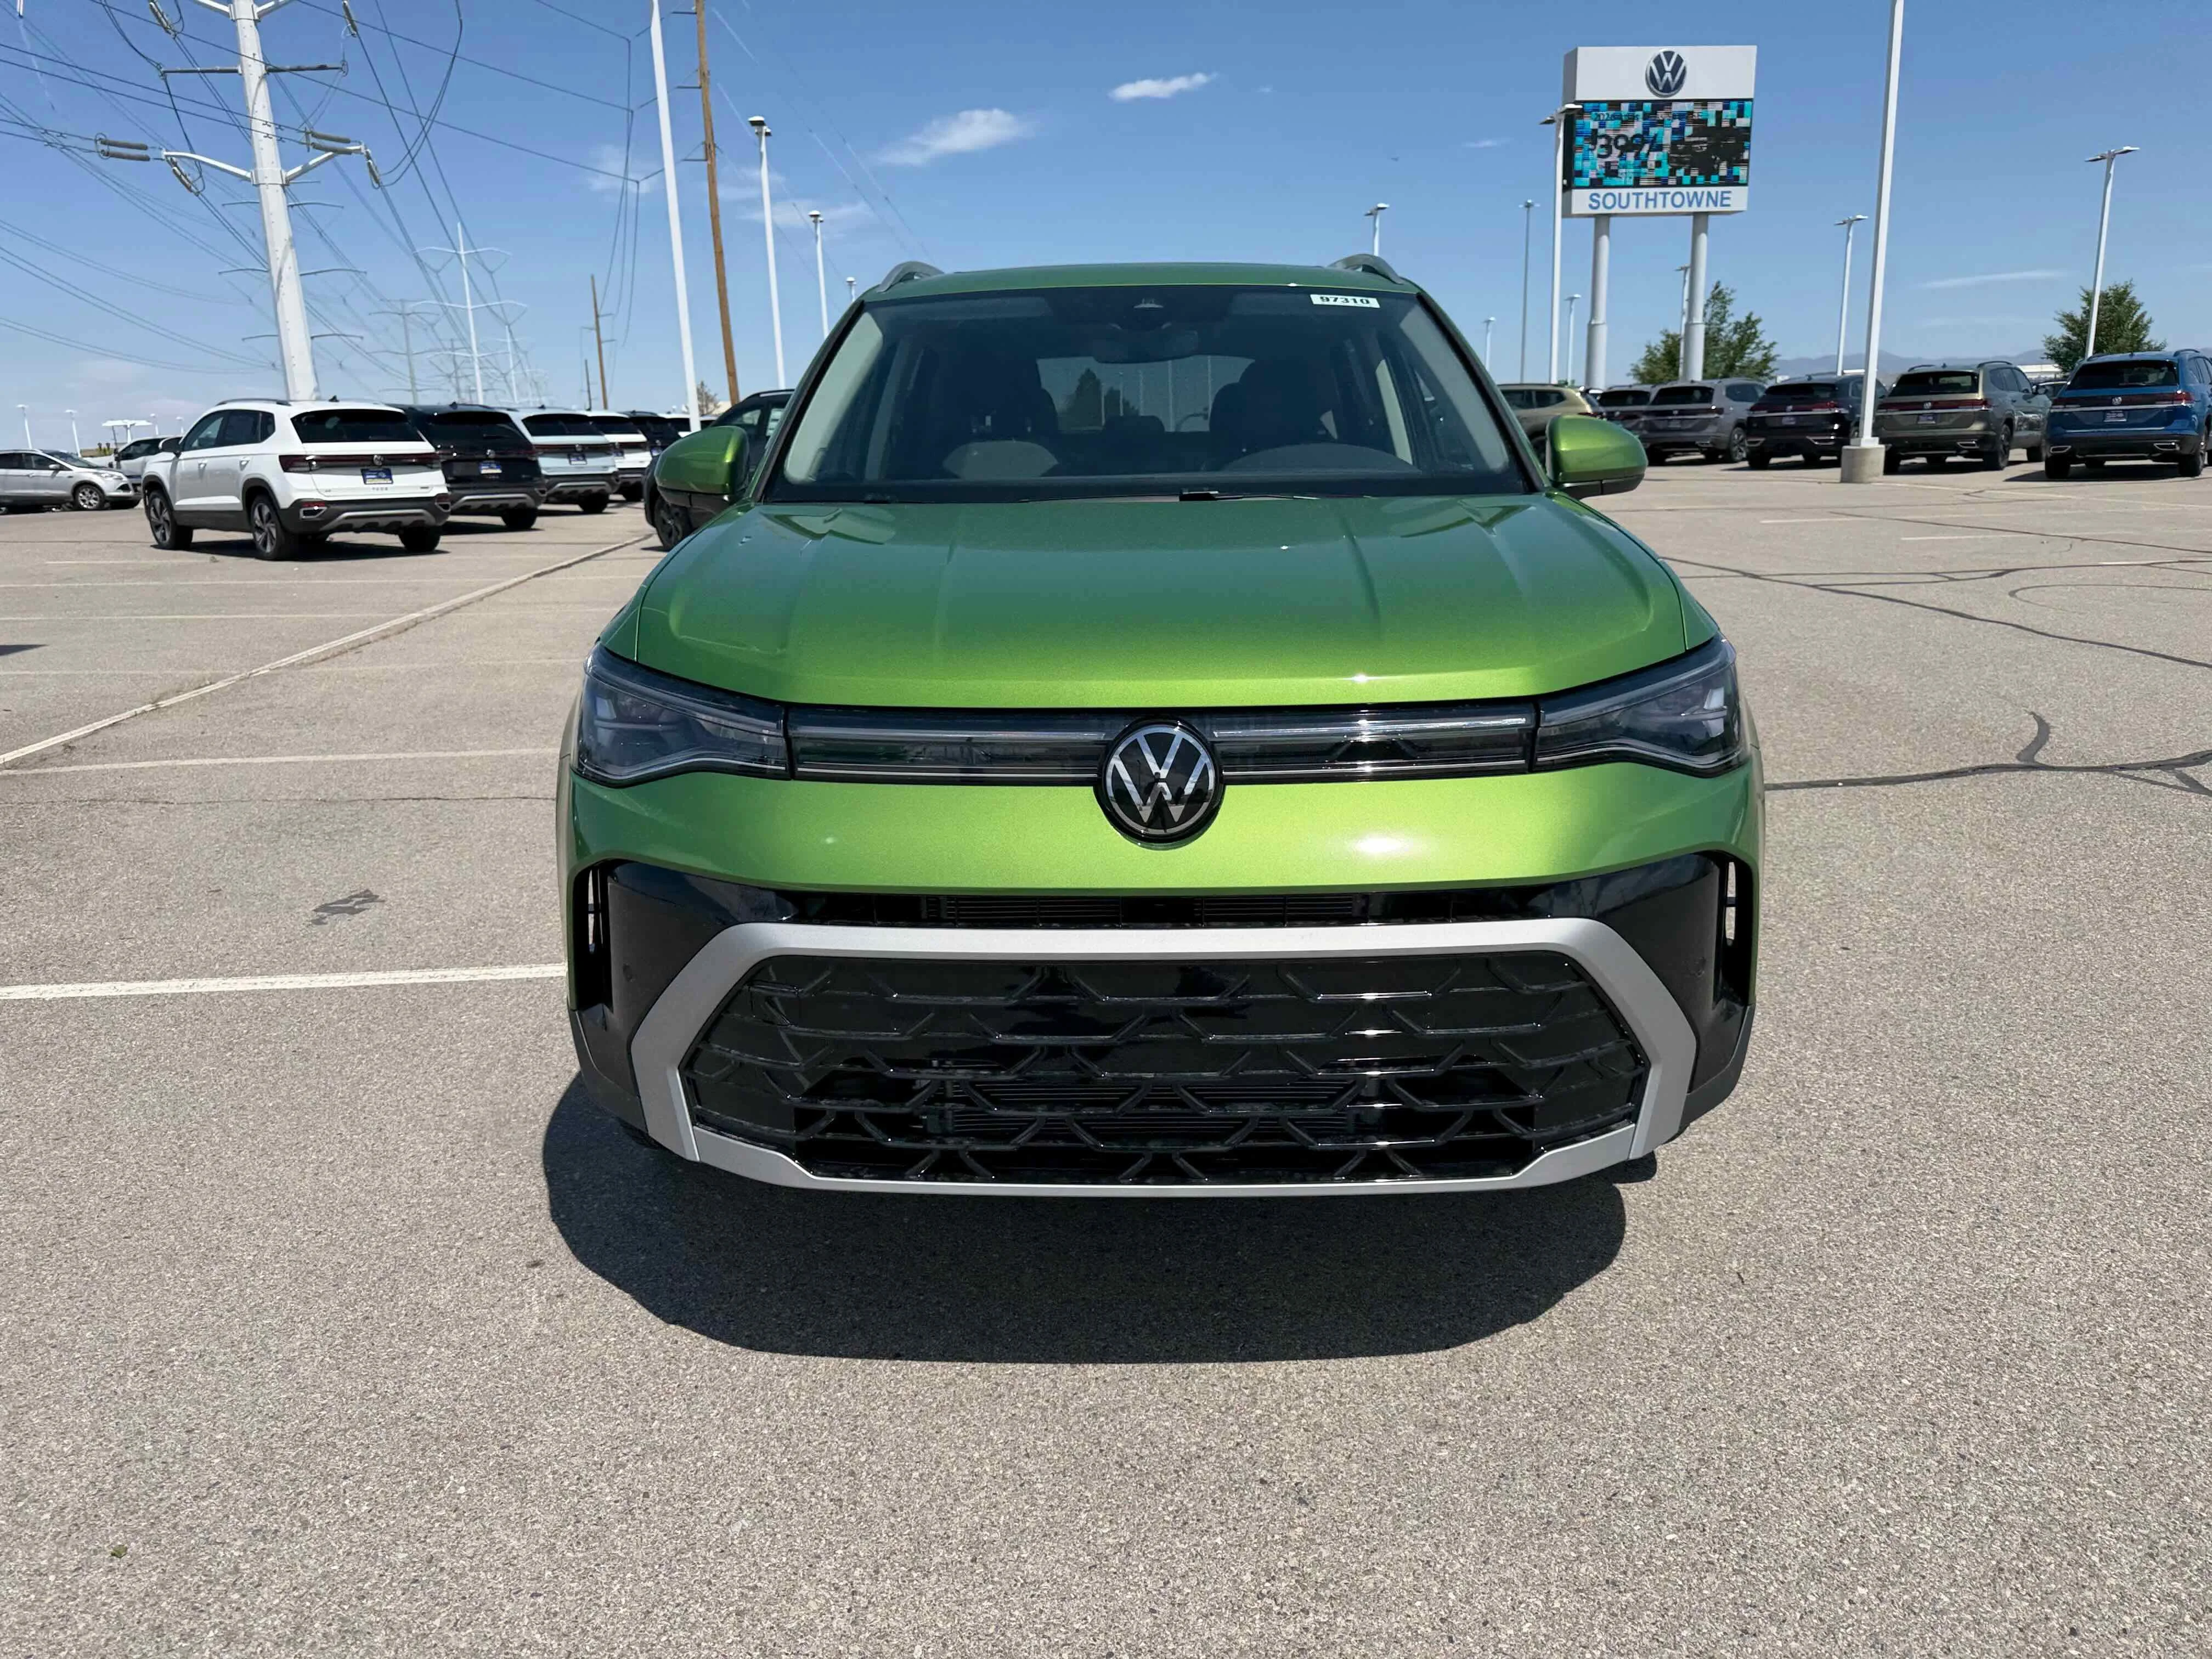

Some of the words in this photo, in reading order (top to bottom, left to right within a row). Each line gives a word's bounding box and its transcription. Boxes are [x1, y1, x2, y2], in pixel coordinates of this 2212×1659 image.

[1649, 50, 1686, 91] VW
[1588, 190, 1732, 210] SOUTHTOWNE
[1319, 296, 1370, 304] 97310
[1109, 729, 1211, 824] VW
